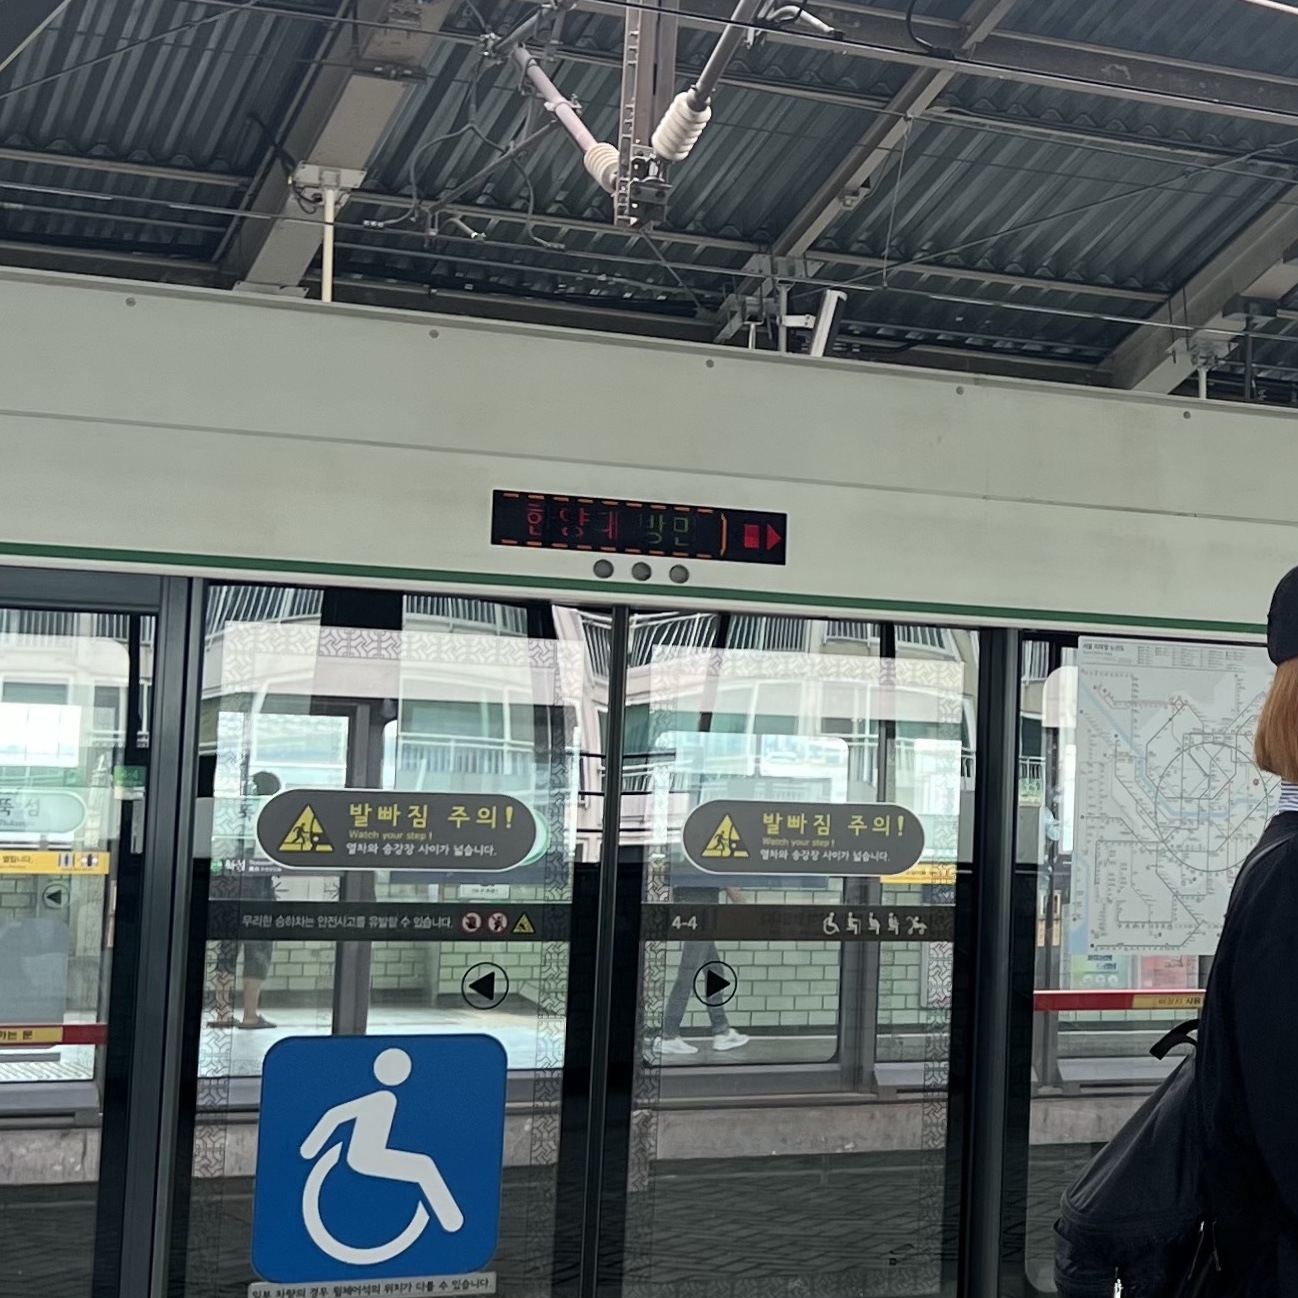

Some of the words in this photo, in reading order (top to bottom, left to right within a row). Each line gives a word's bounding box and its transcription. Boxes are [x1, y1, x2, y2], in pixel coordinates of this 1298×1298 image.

[349, 803, 428, 828] 발빠짐
[447, 805, 514, 829] 주의!
[763, 812, 831, 836] 발빠짐
[848, 815, 905, 836] 주의!
[349, 830, 379, 839] Watch
[382, 831, 404, 841] your
[762, 837, 788, 846] Watch
[792, 839, 811, 847] your
[346, 843, 379, 855] 열차와
[382, 843, 415, 855] 승강장
[418, 843, 449, 856] 사이가
[454, 844, 498, 857] 넓습니다.
[760, 849, 788, 861] 열차와
[792, 850, 819, 861] 승강장
[823, 850, 850, 861] 사이가
[242, 915, 272, 928] 무리한
[275, 916, 314, 928] 승하차는
[317, 916, 365, 928] 안전사고를
[401, 916, 410, 928] 수
[414, 917, 453, 928] 있습니다.
[672, 916, 698, 930] 4-4
[310, 1285, 329, 1298] 경우
[384, 1282, 412, 1295] 위치가
[415, 1280, 434, 1293] 다를
[439, 1280, 448, 1291] 수
